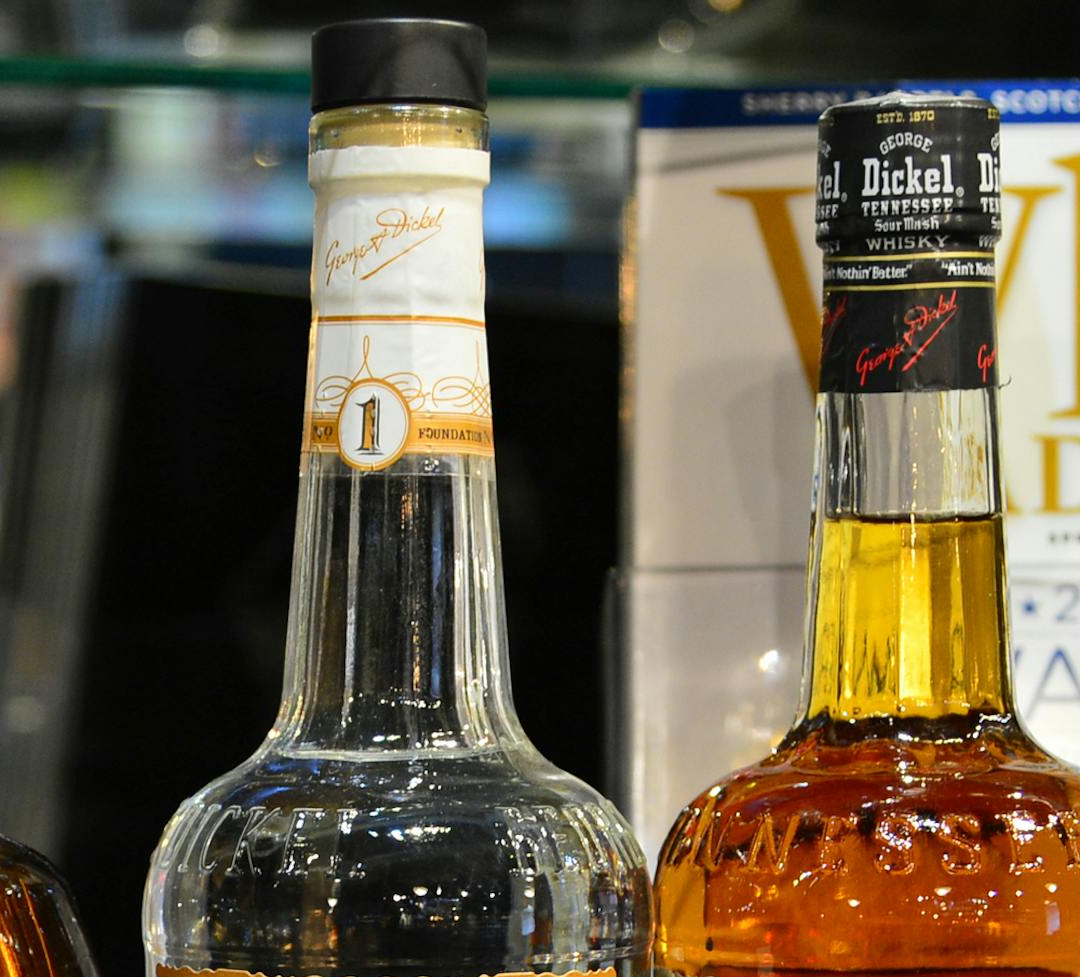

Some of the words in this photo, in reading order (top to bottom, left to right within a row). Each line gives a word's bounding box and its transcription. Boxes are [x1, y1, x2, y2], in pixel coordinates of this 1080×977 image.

[990, 88, 1080, 115] SCOTC
[909, 109, 935, 122] 1870
[879, 132, 934, 155] GEORGE
[861, 153, 955, 197] Dickel
[861, 197, 954, 217] TENNESSEE
[874, 218, 903, 232] Sour
[904, 214, 940, 231] Mash
[325, 240, 374, 287] George
[376, 205, 446, 241] Dickel
[865, 234, 950, 251] WHISKY
[836, 265, 871, 281] Nothin'
[904, 288, 958, 332] Dickel
[354, 396, 386, 456] 1
